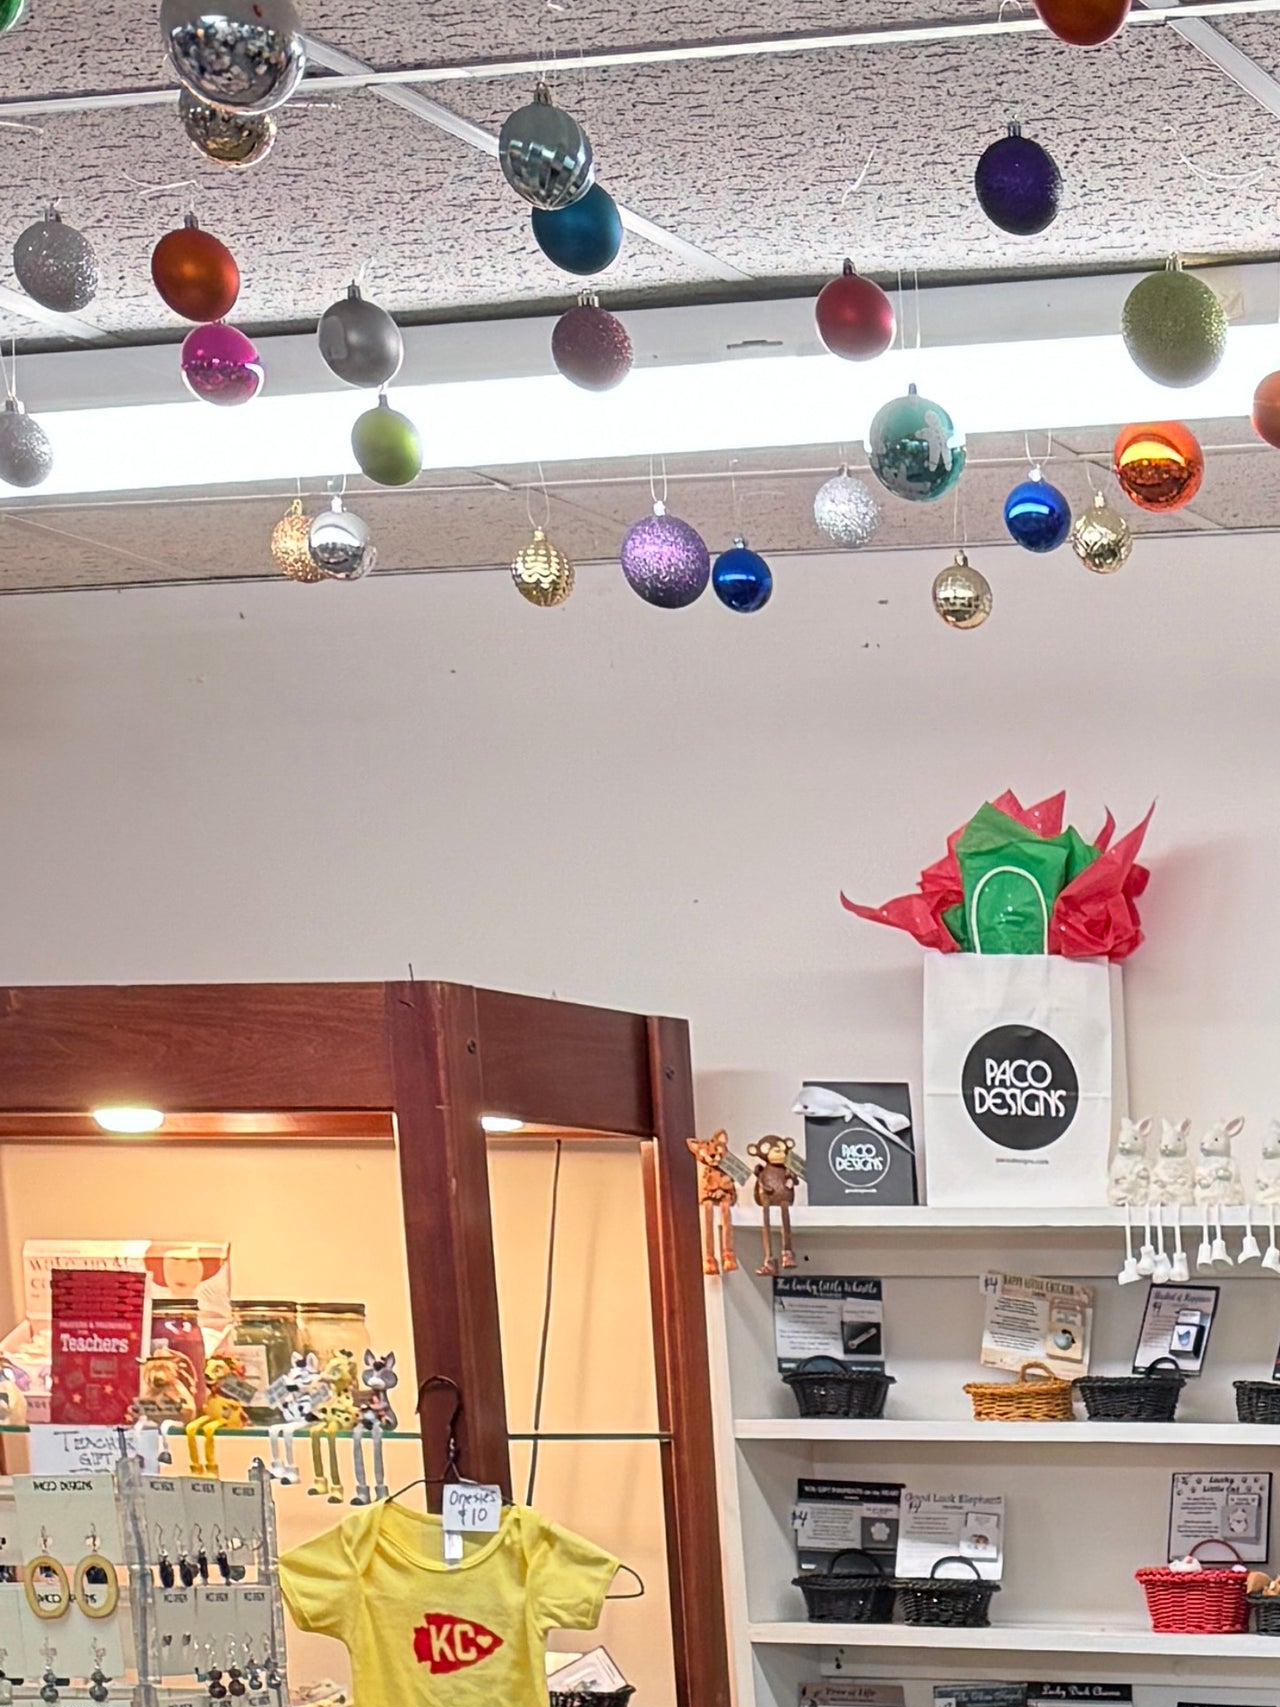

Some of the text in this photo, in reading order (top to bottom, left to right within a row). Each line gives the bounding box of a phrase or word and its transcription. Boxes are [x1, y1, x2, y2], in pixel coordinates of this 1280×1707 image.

[986, 1058, 1052, 1089] PACO
[973, 1086, 1067, 1118] DESIGNS
[841, 1144, 876, 1158] PACO
[835, 1157, 884, 1172] DESIGNS
[60, 1334, 129, 1354] Teachers
[904, 1492, 931, 1502] Good
[933, 1493, 957, 1503] Luck
[429, 1623, 478, 1663] KC
